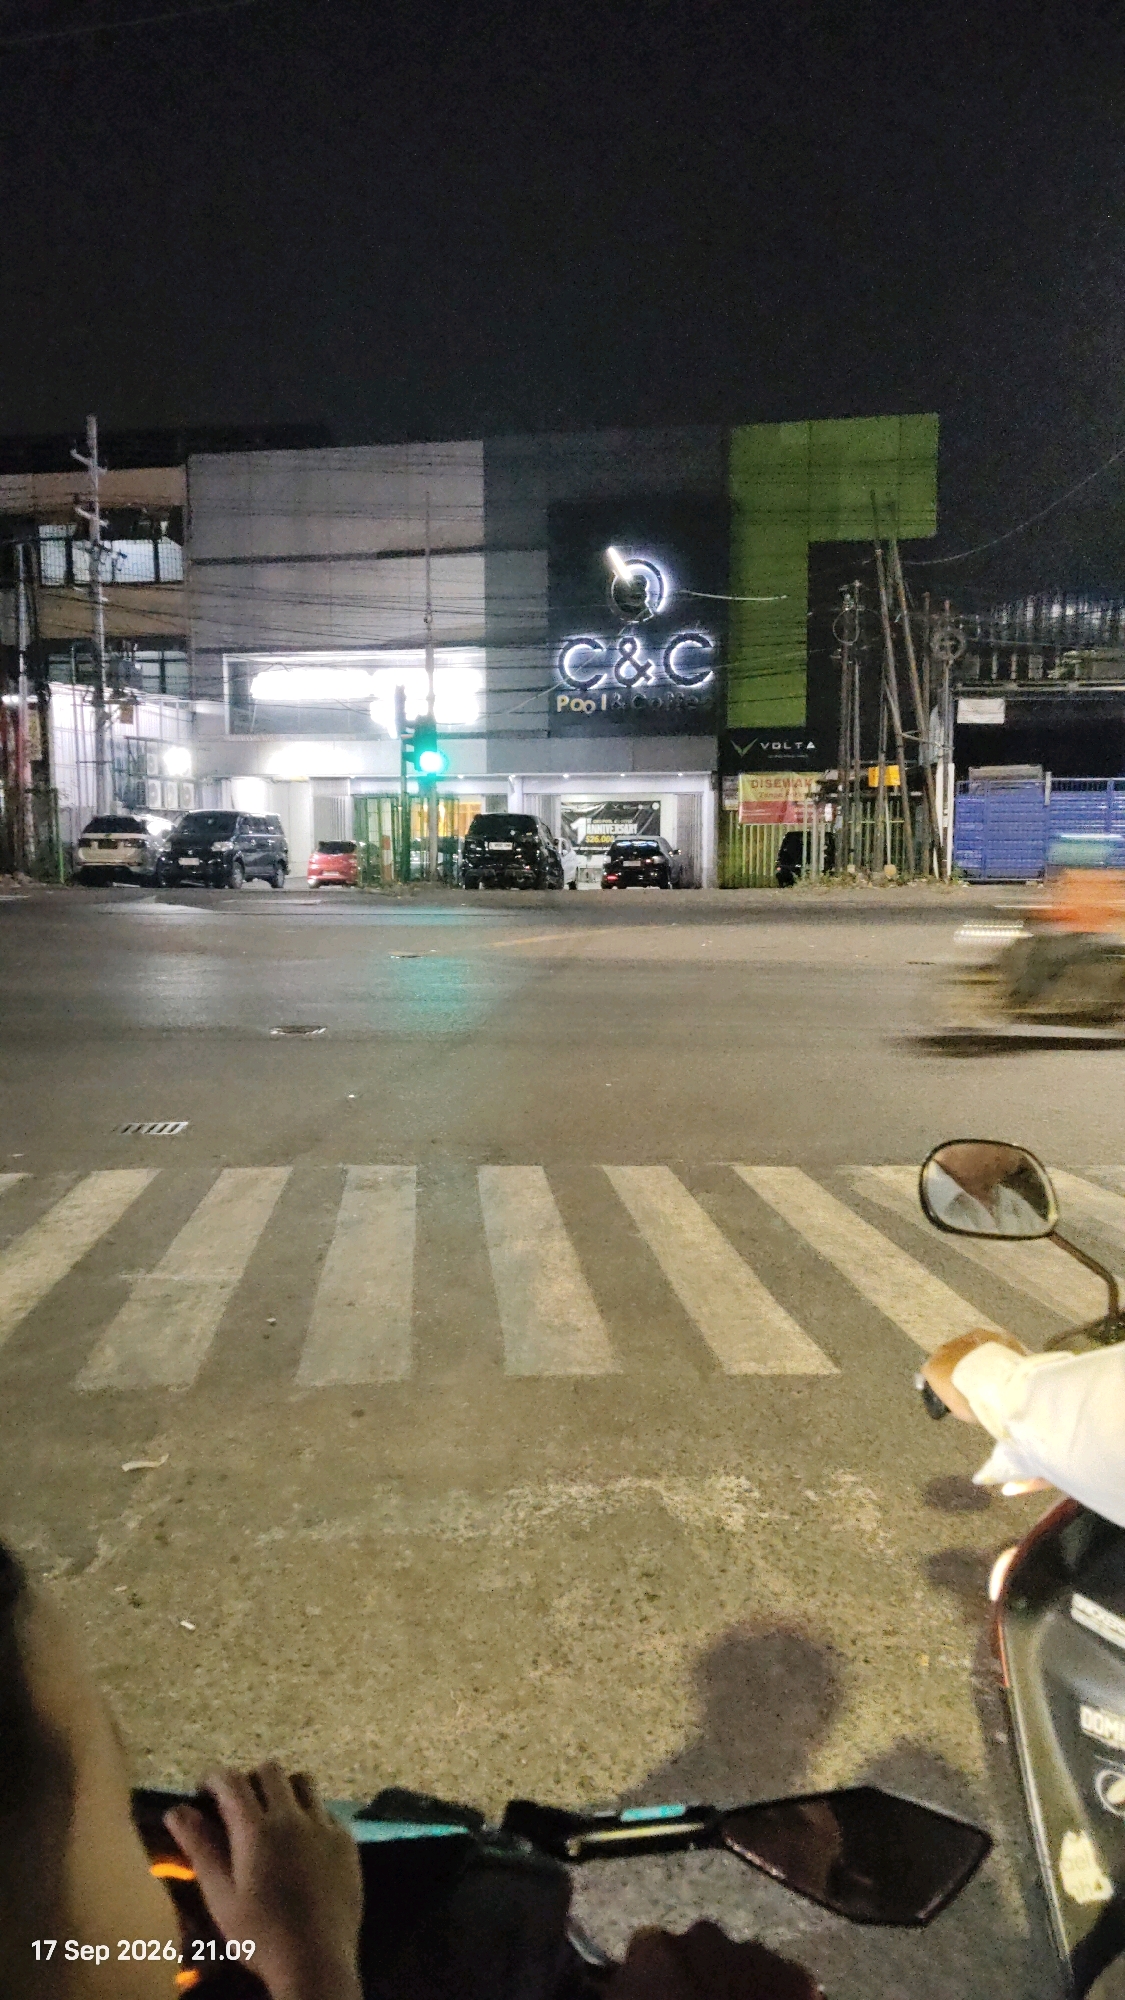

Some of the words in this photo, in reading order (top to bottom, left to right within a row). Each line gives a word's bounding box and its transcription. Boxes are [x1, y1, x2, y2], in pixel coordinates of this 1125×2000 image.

[558, 632, 714, 690] C&C
[556, 693, 607, 714] Pool
[760, 741, 815, 750] VOLTA
[751, 778, 814, 789] DISEWAK
